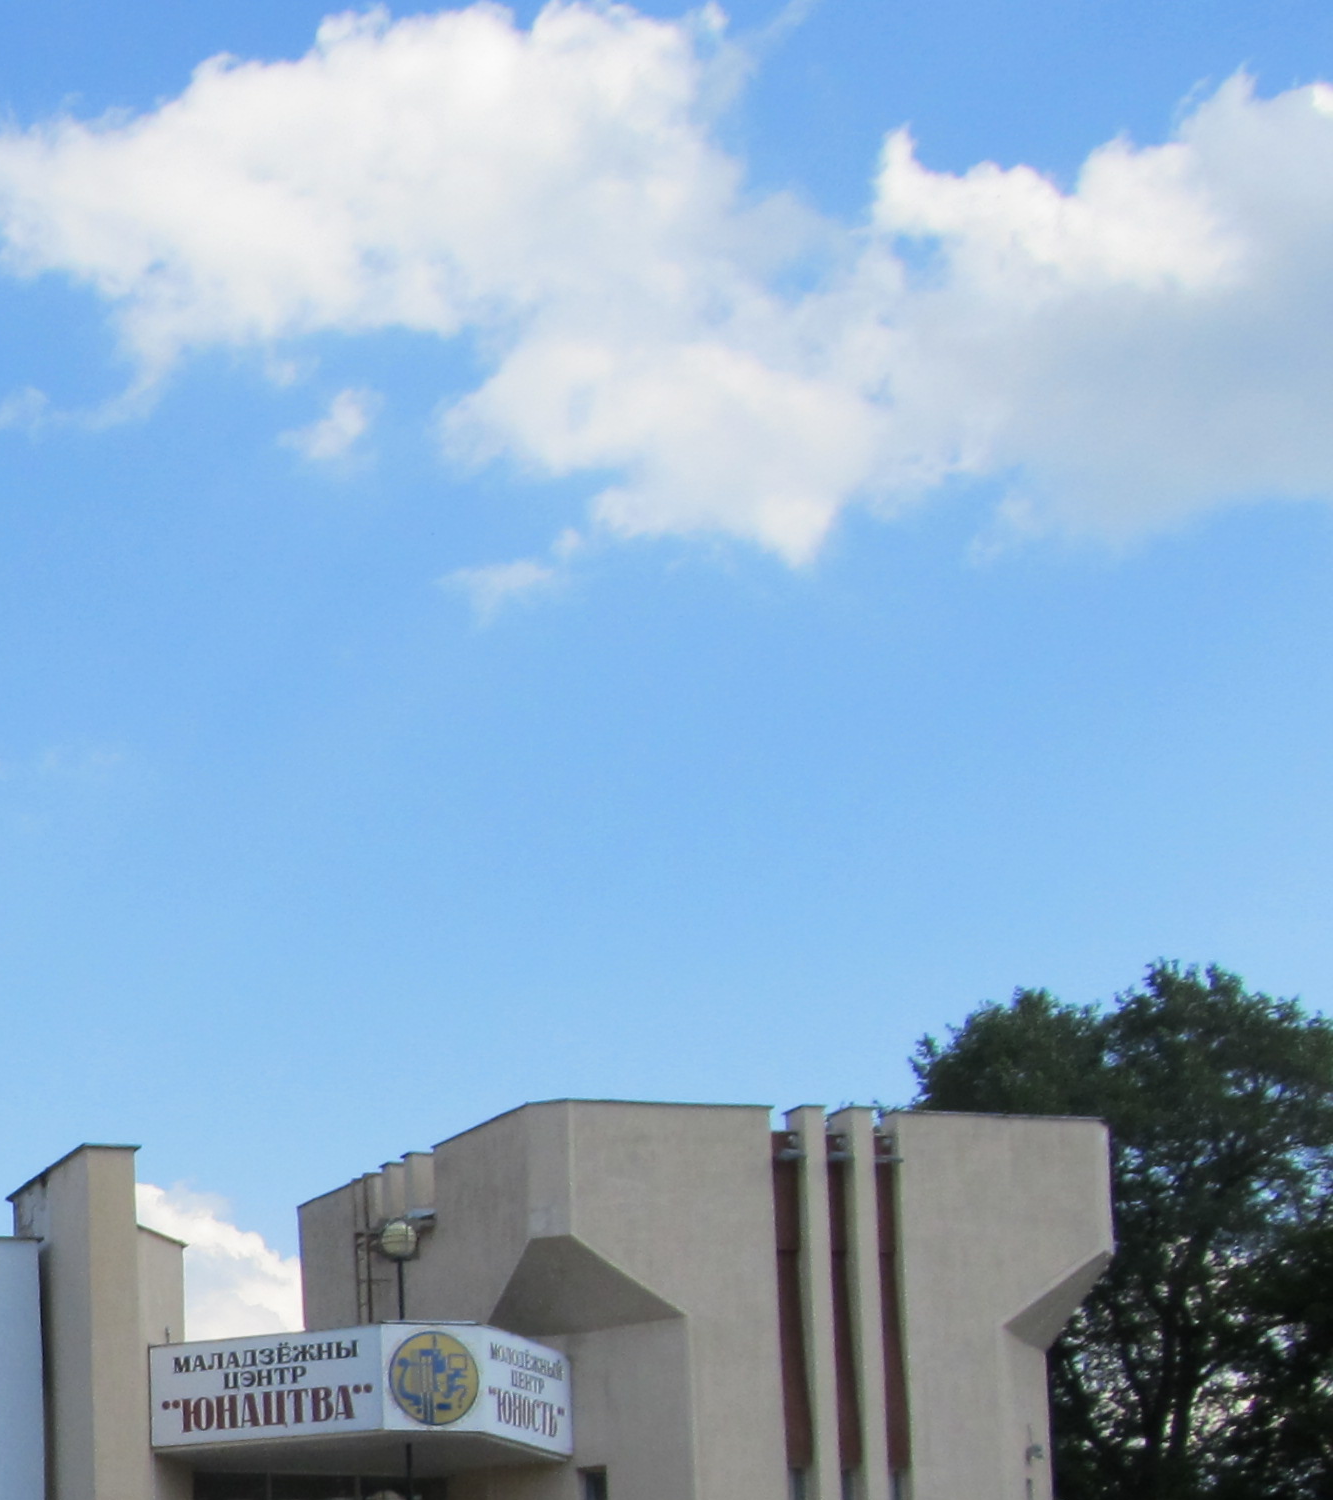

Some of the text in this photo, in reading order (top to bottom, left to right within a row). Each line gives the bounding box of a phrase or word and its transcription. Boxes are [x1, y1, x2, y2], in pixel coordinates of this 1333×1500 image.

[173, 1339, 359, 1374] МАЛАДЗЁЖНЫ
[223, 1365, 307, 1391] ЦЭНТР
[511, 1369, 545, 1394] ЦЕНТР
[488, 1386, 565, 1438] "ЮНОСТЬ"
